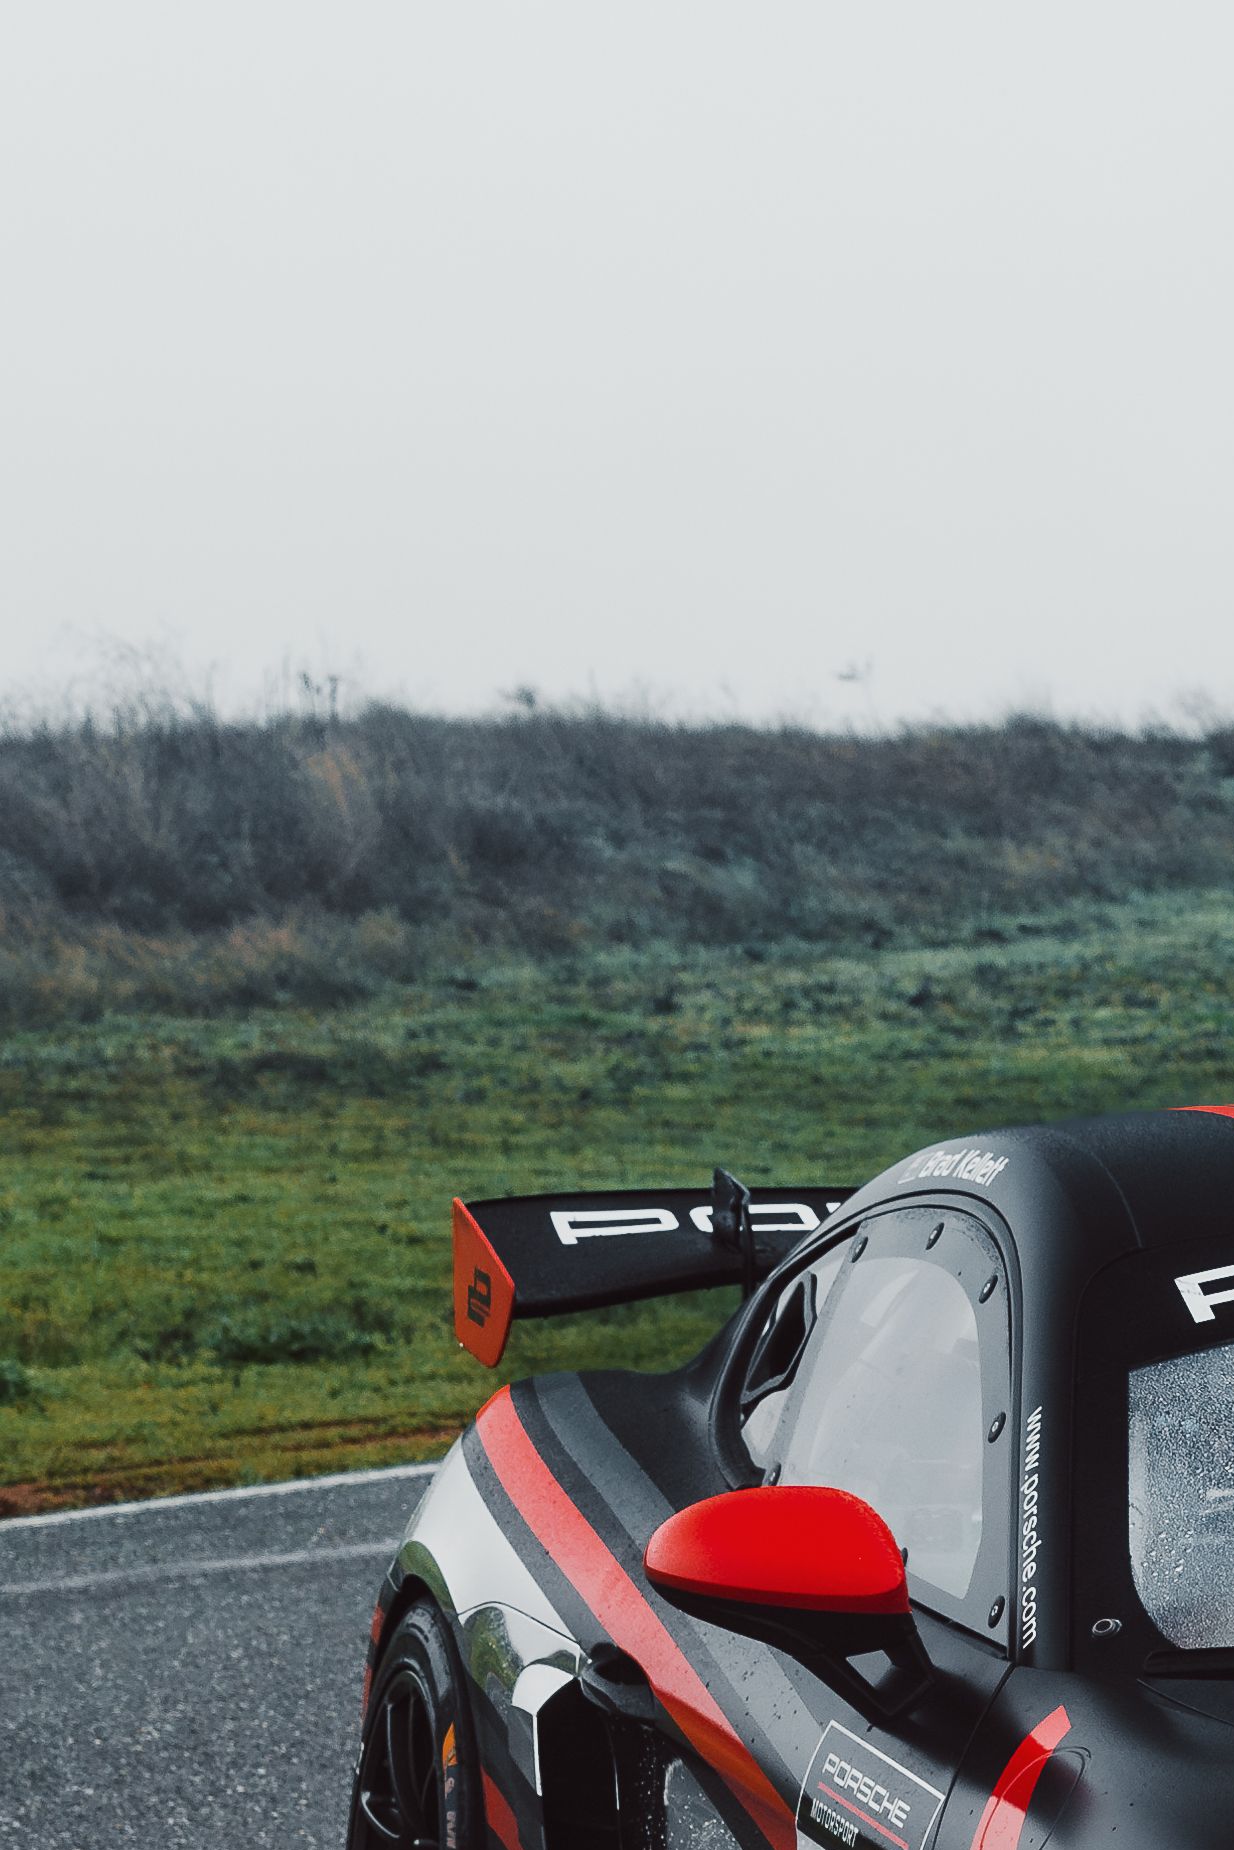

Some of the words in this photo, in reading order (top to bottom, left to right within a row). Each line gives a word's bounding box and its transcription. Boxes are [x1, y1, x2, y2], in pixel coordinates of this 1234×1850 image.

[918, 1149, 967, 1178] Brad
[1020, 1405, 1043, 1650] www.porsche.com
[821, 1752, 911, 1830] PORSCHE
[809, 1798, 860, 1850] MOTORSPORT
